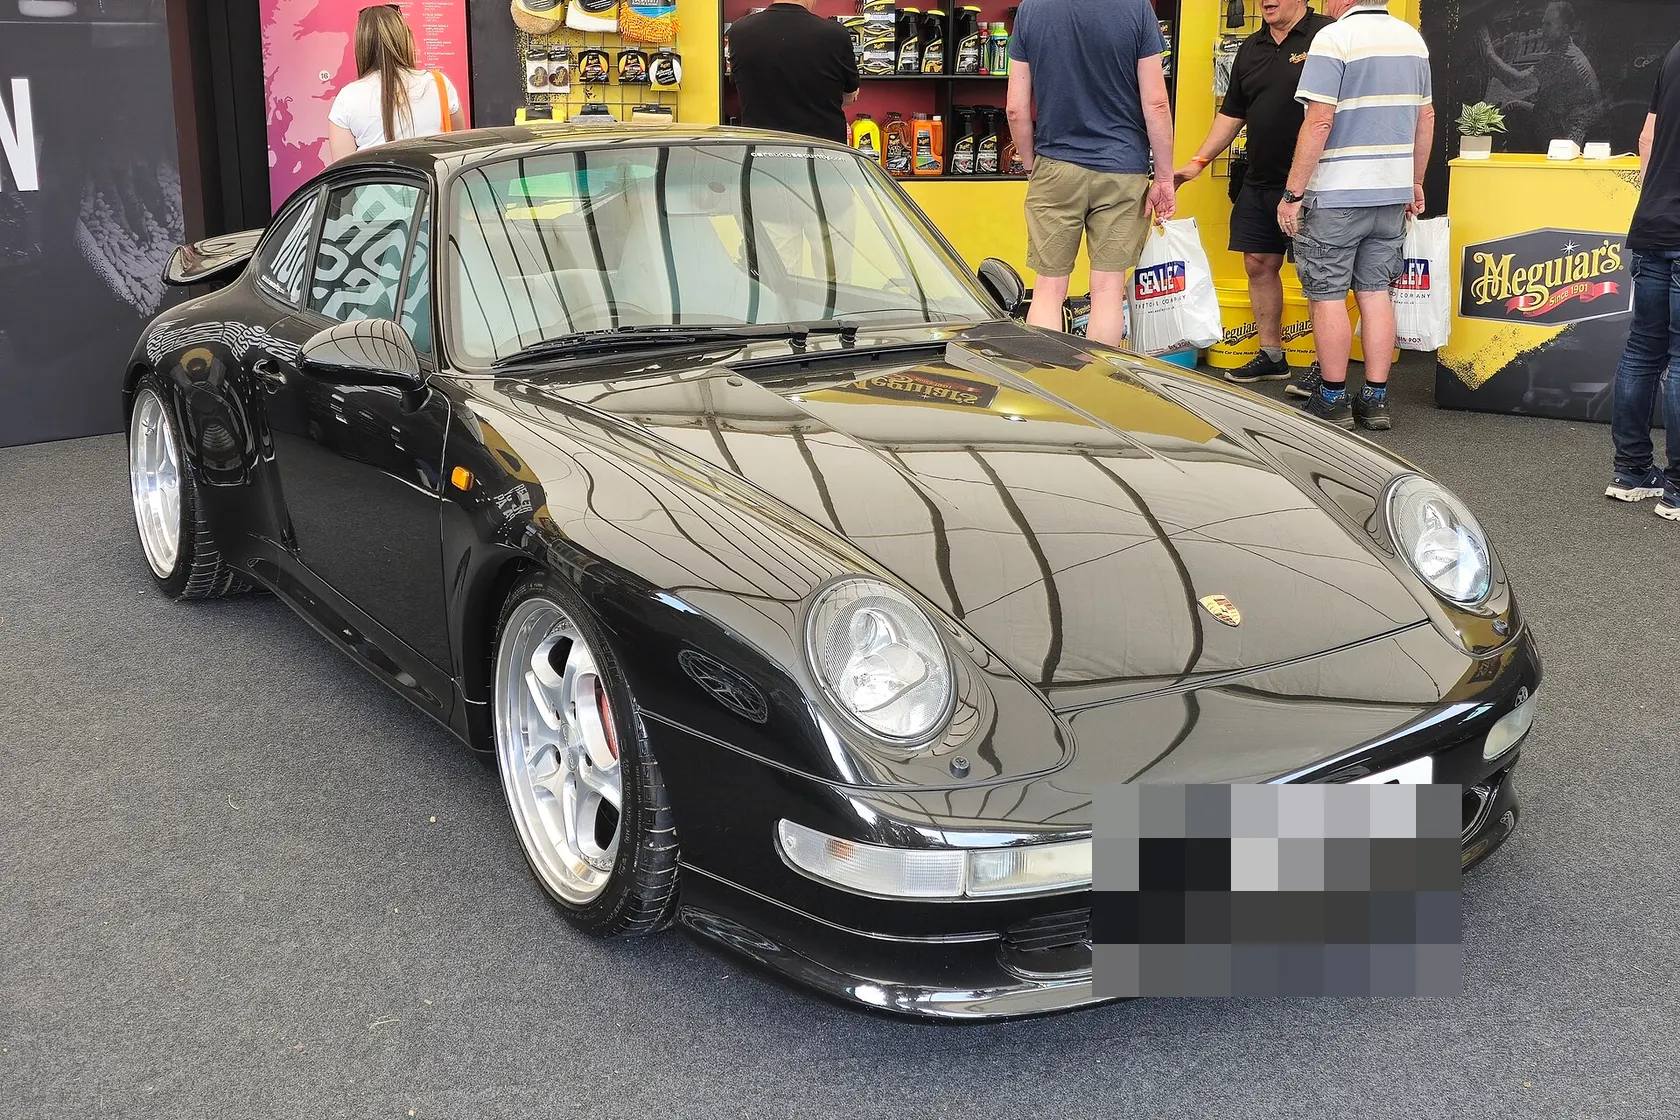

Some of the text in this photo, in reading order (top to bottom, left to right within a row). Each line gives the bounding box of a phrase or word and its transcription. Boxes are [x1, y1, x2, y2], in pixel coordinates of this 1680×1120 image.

[321, 72, 329, 80] 16
[1398, 262, 1425, 286] LEY
[1471, 240, 1622, 312] Meguiar's
[1549, 284, 1588, 307] Since 1901
